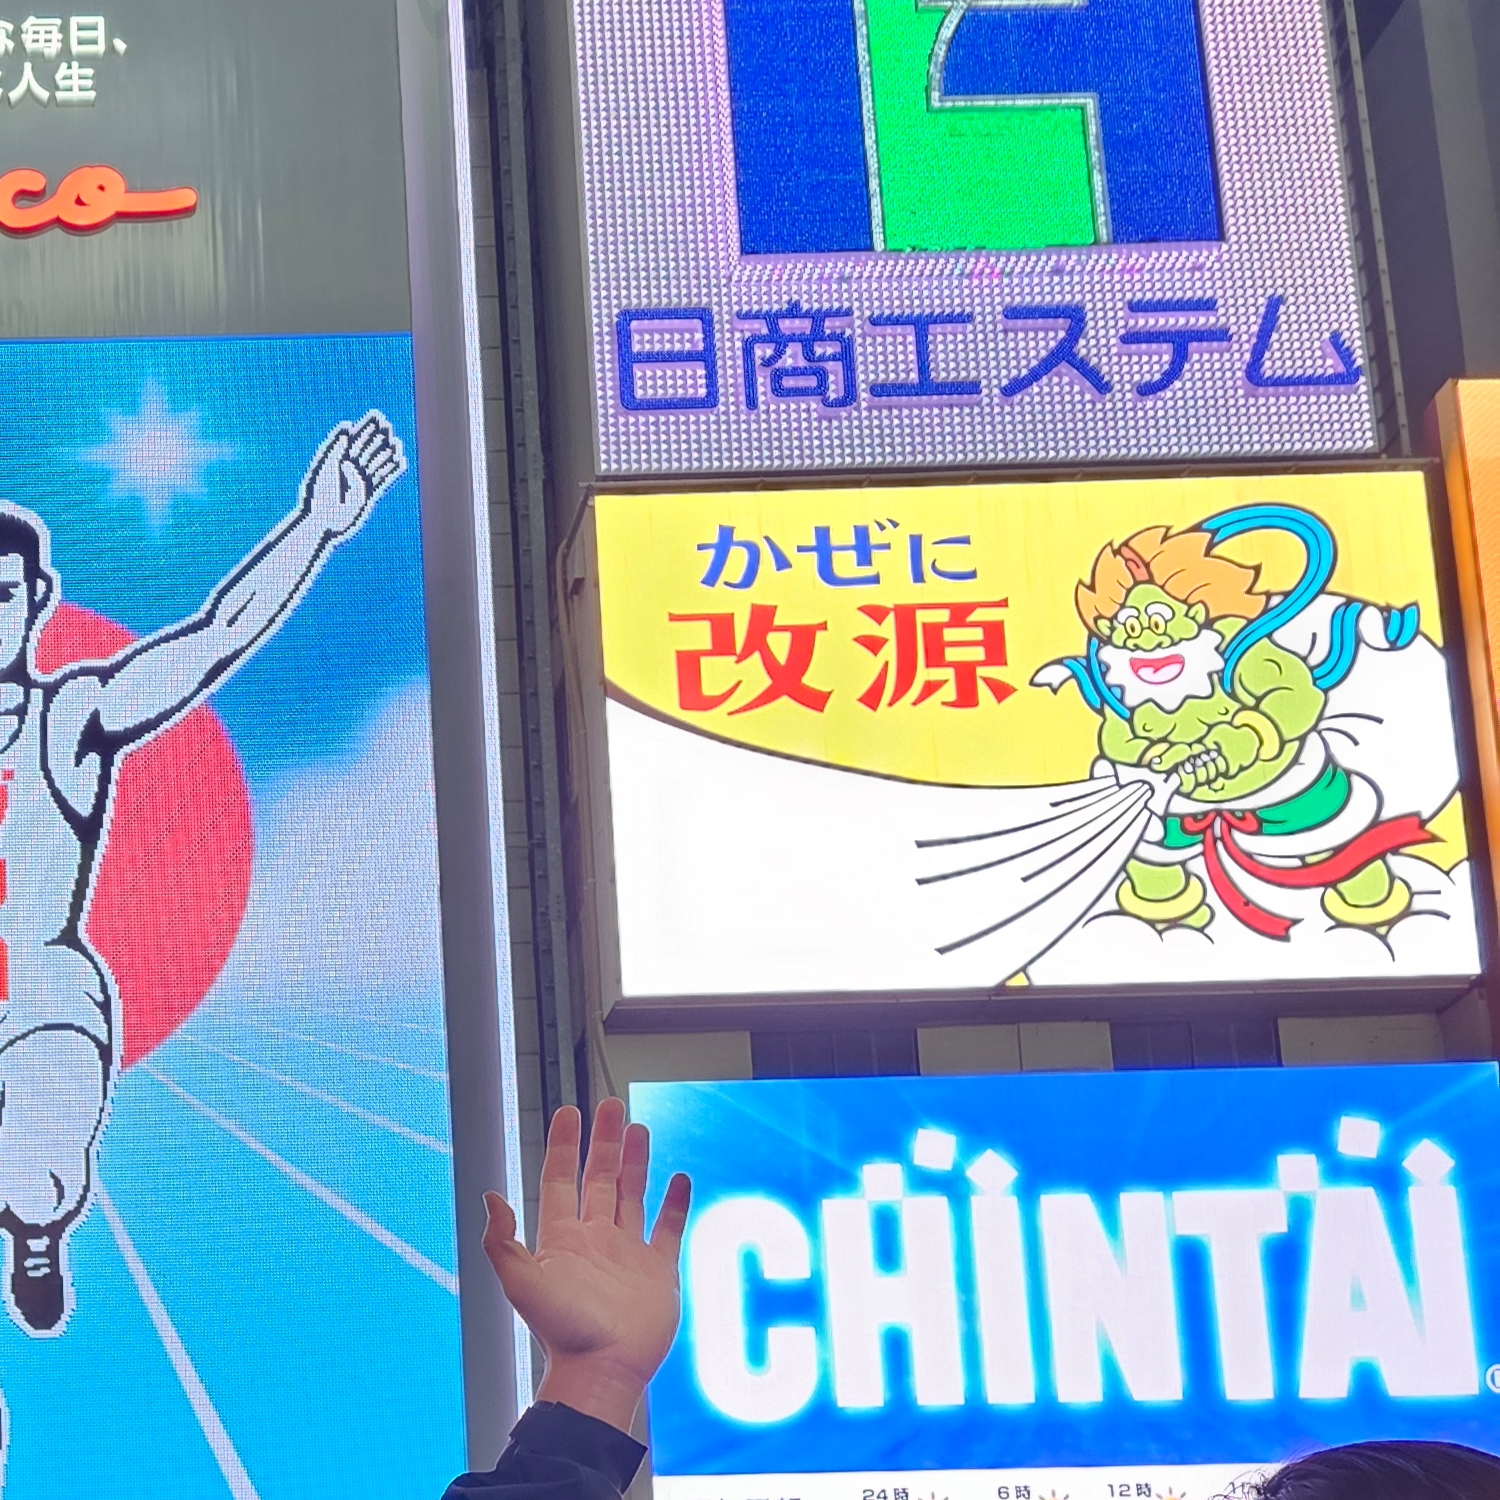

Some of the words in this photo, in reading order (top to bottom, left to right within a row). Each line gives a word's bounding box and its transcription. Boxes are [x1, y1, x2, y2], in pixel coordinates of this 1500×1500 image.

[616, 295, 1362, 411] 日商エステム
[695, 518, 978, 590] かぜに
[667, 598, 1018, 714] 改源
[688, 1150, 1479, 1424] CHINTAI
[1108, 1482, 1153, 1499] 12時
